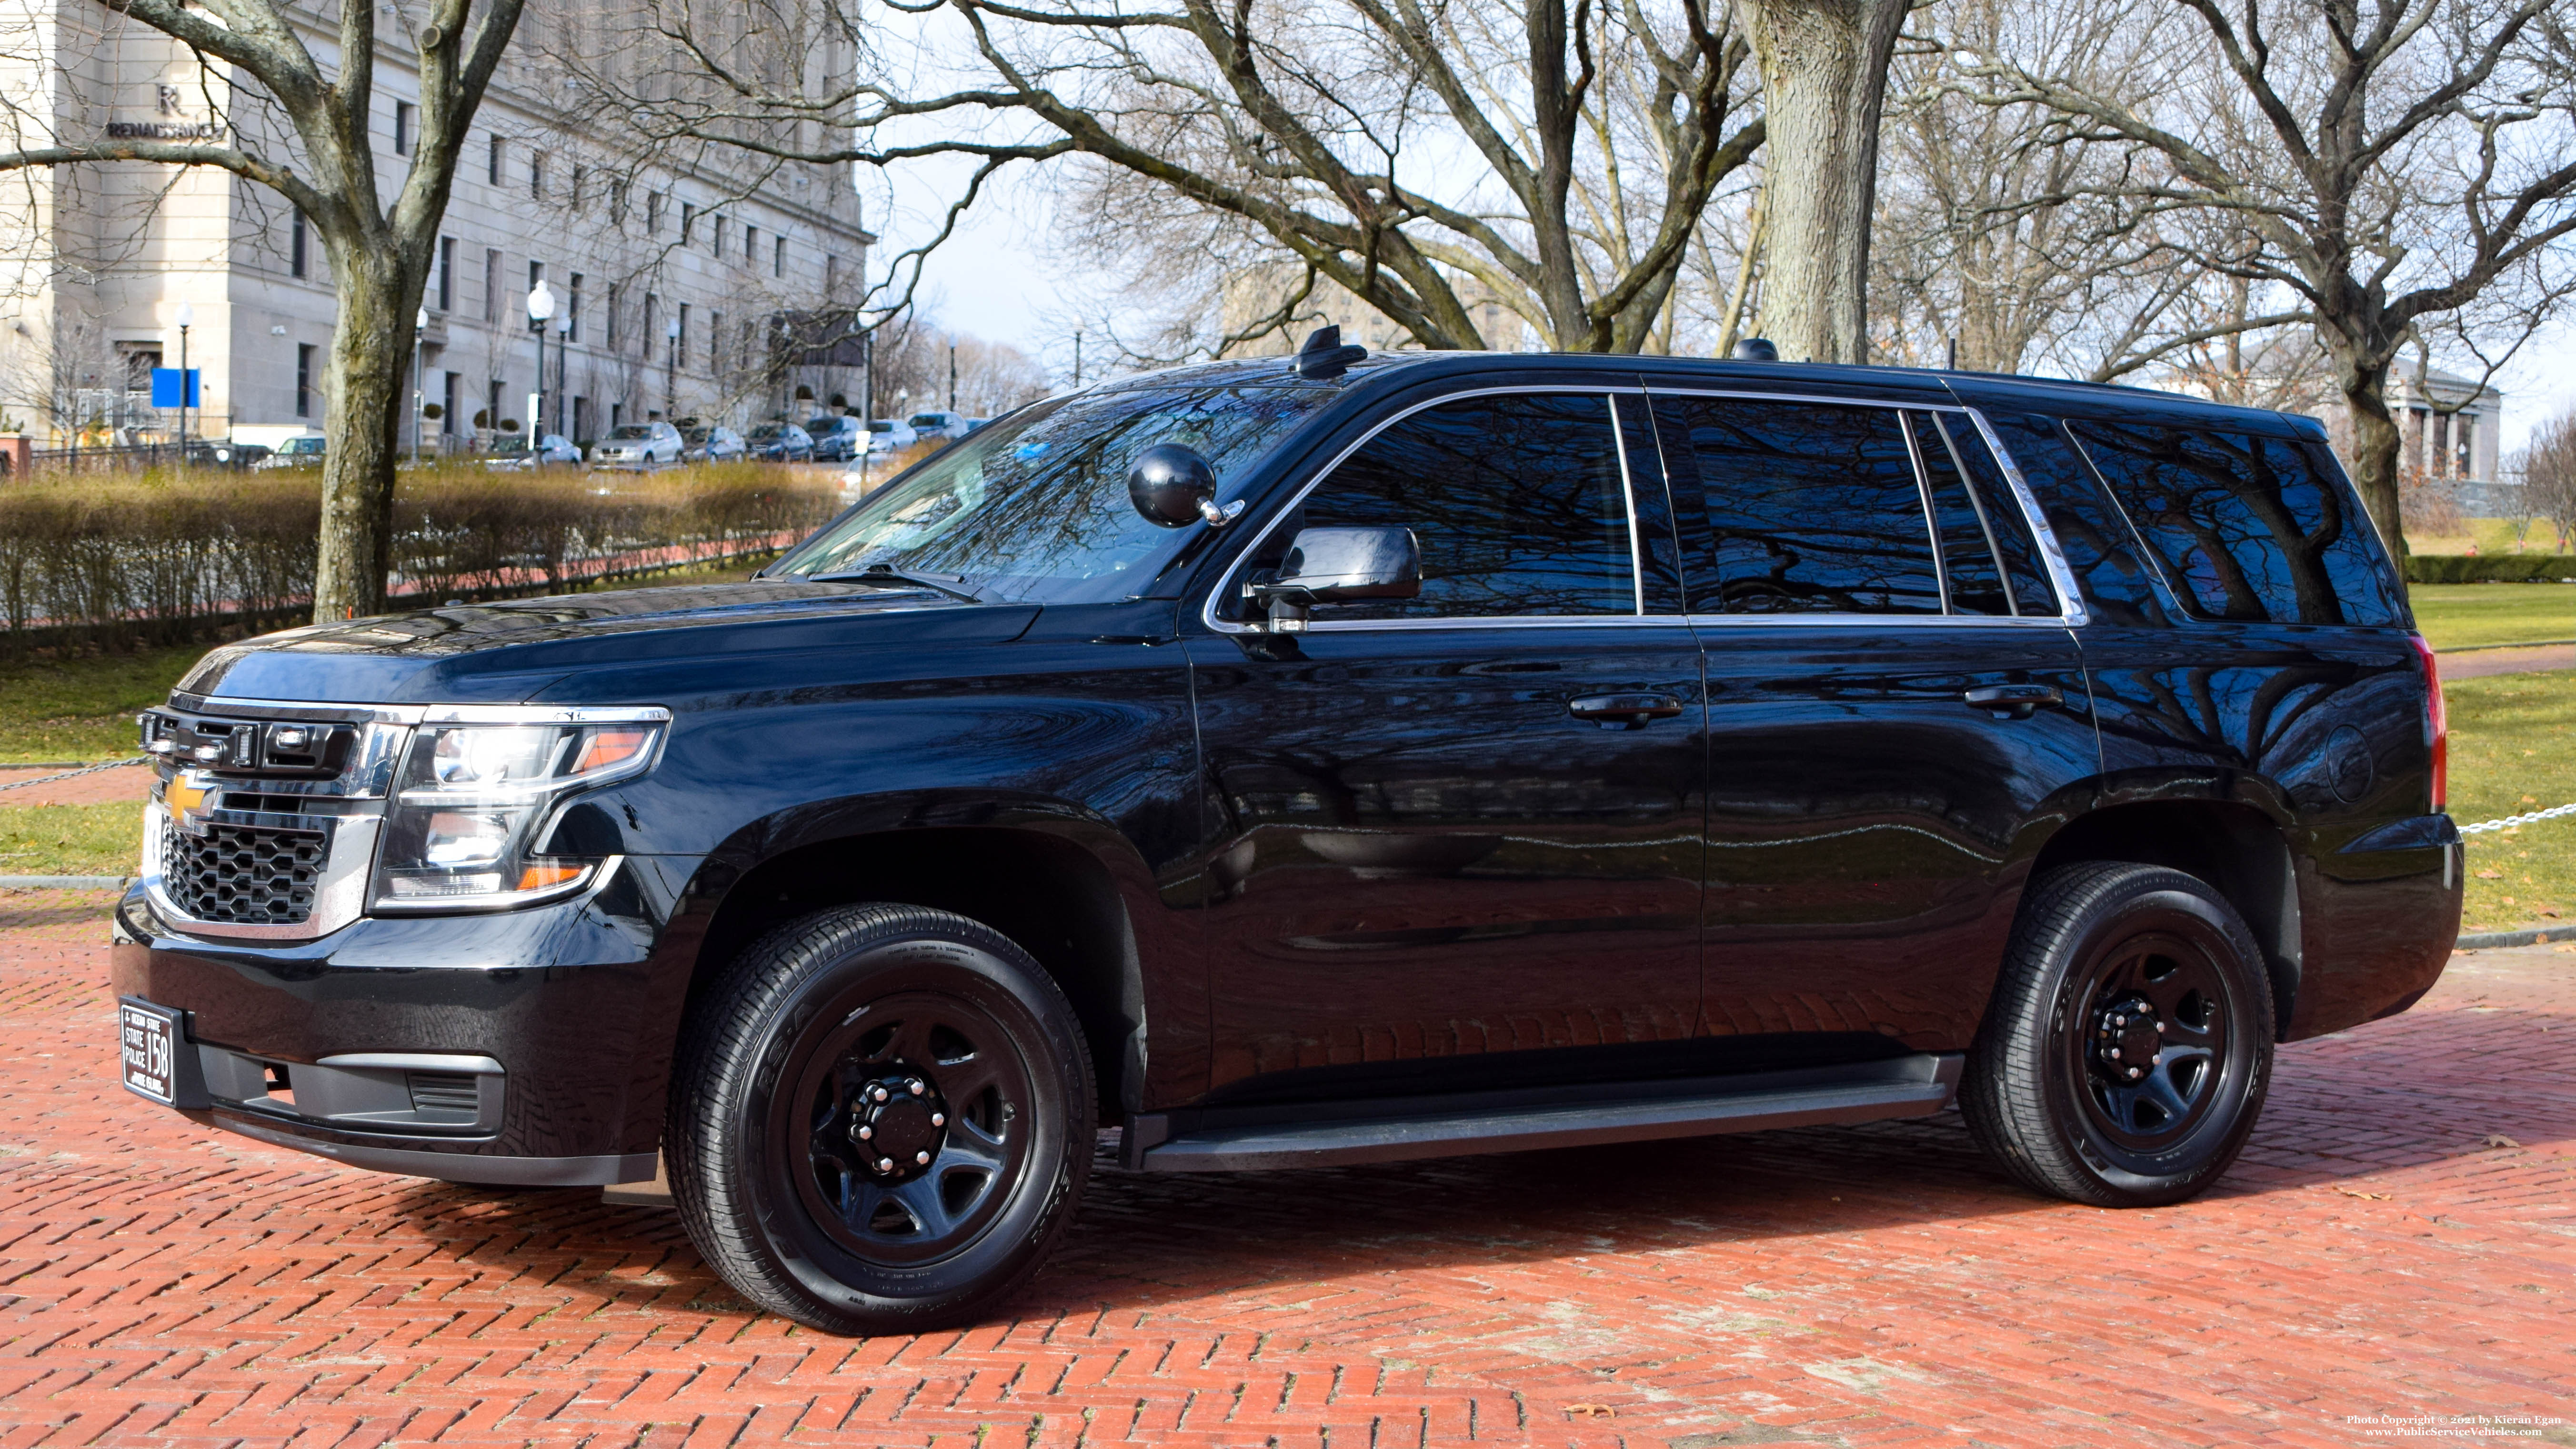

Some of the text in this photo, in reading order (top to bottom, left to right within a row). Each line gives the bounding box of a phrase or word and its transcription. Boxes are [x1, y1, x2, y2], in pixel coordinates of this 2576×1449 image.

[156, 84, 188, 115] R
[108, 123, 226, 137] RENAISSANCE
[131, 1013, 160, 1033] OCEAN STATE
[125, 1027, 144, 1048] STATE
[125, 1046, 146, 1068] POLICE
[147, 1031, 169, 1078] 158
[146, 1076, 161, 1093] ISLAND
